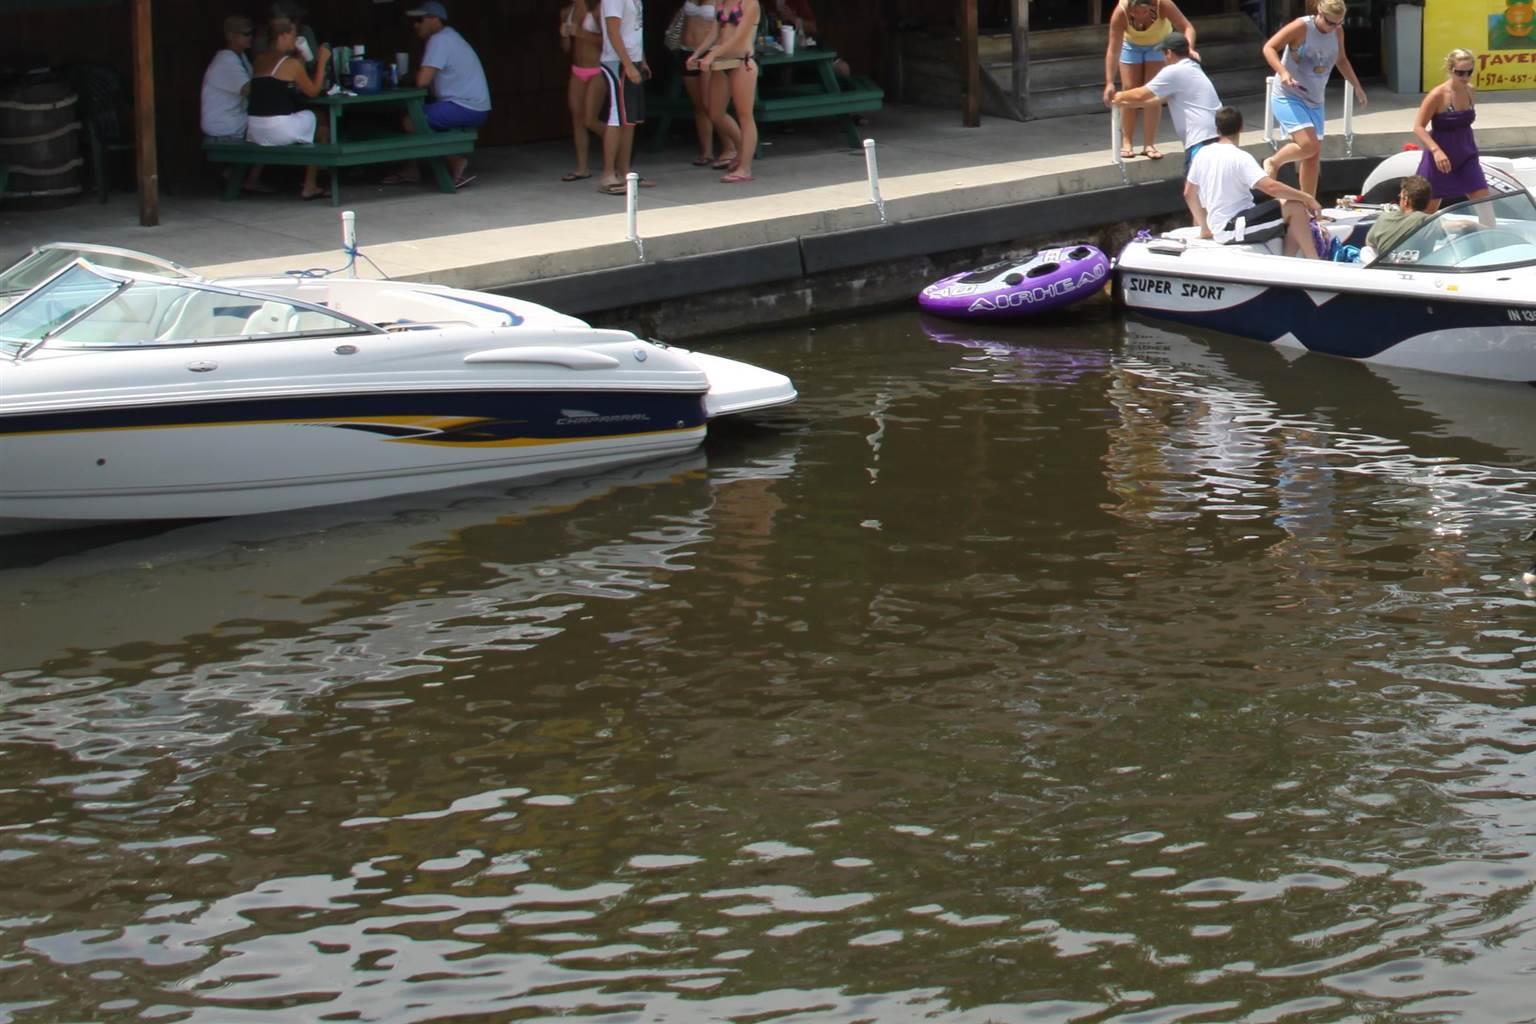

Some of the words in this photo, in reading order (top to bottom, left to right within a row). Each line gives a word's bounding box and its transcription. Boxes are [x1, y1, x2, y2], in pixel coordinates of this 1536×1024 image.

[968, 263, 1107, 312] AIRHEAD
[1130, 278, 1172, 295] SUPER
[1181, 283, 1225, 300] SPORT
[1507, 309, 1521, 321] IN
[556, 413, 651, 425] CHAPARRAL
